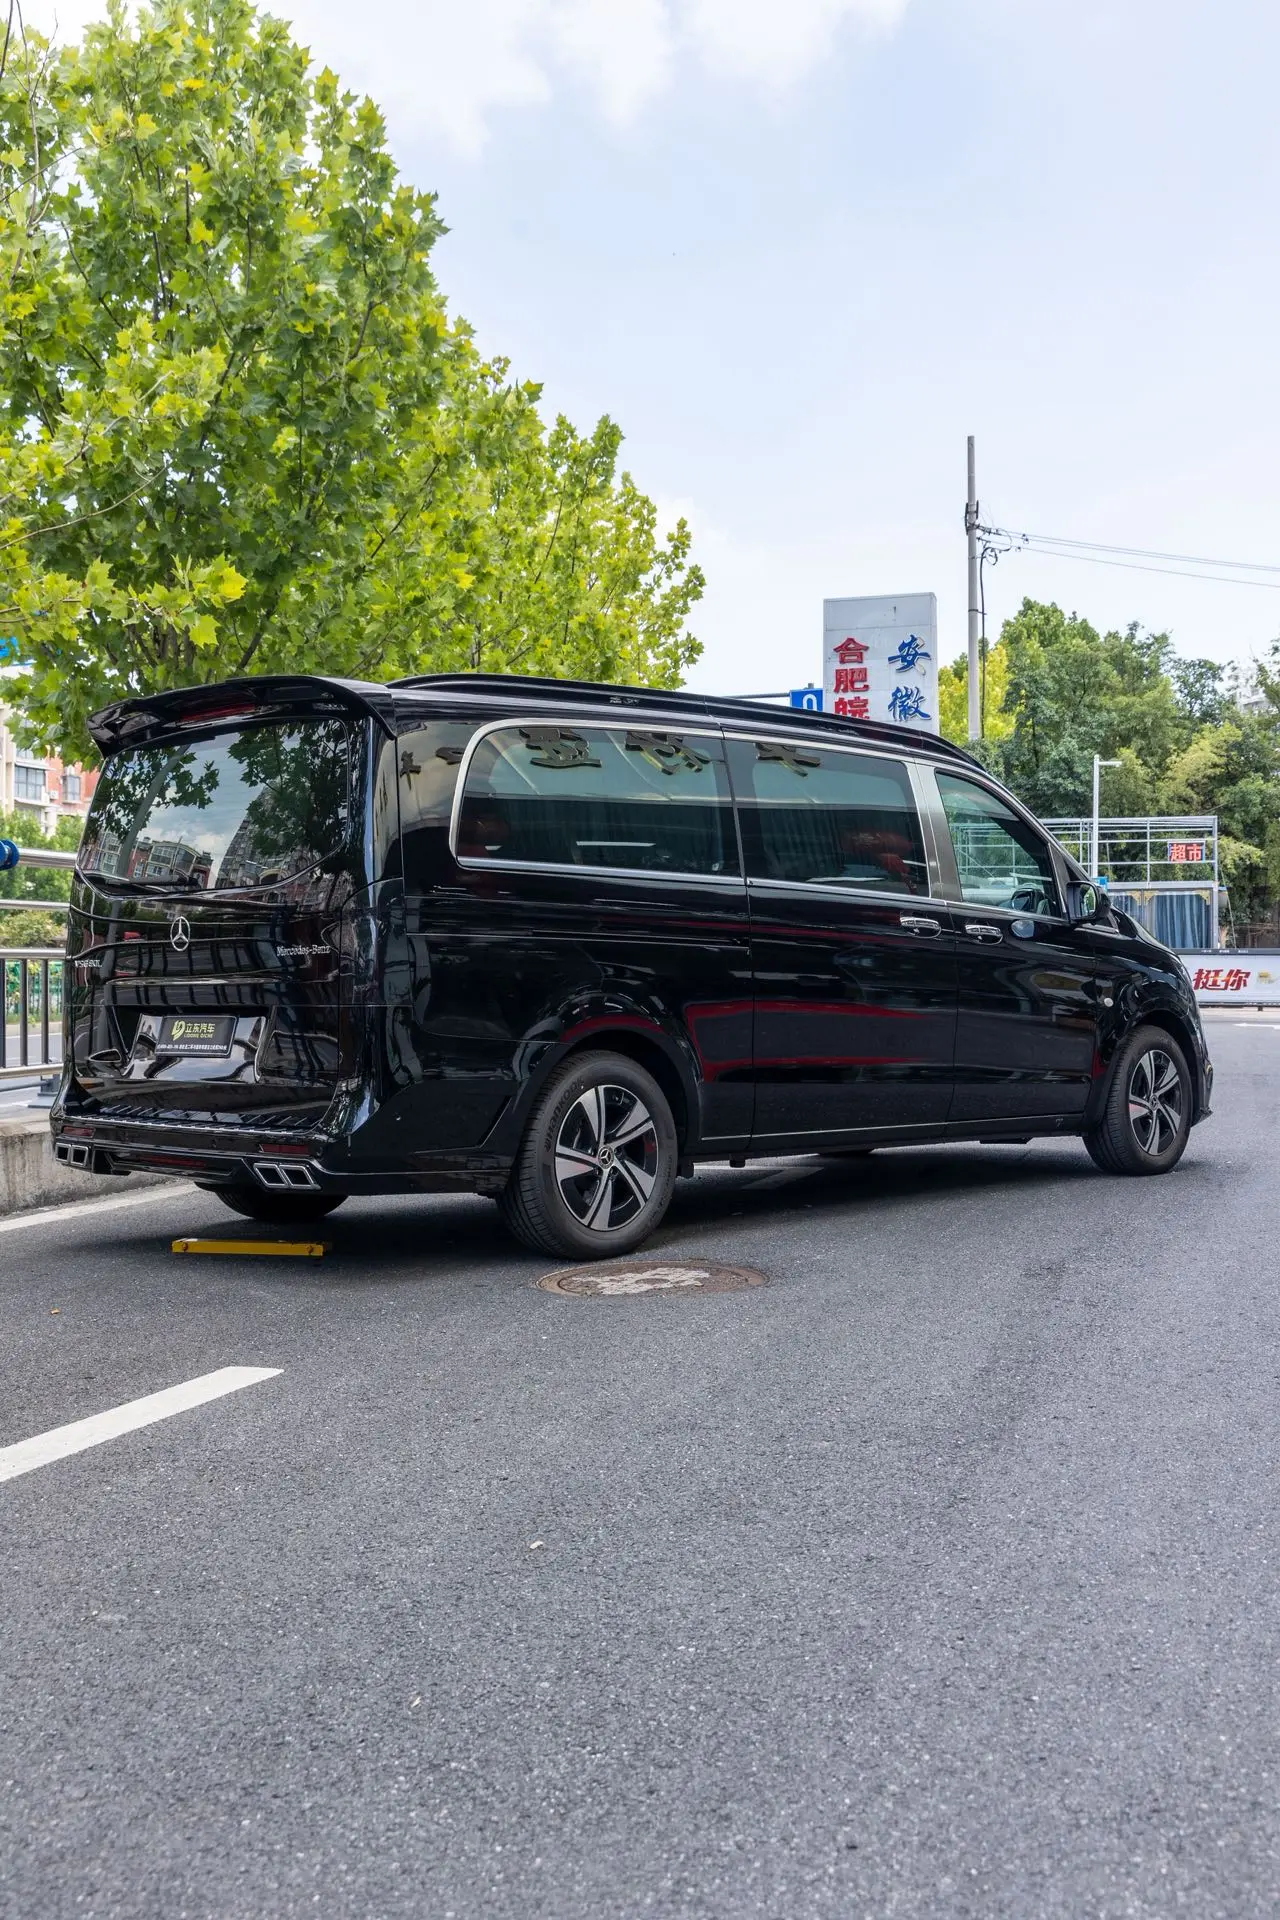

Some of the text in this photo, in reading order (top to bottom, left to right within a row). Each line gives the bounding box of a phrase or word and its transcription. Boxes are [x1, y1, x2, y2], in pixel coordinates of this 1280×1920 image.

[888, 634, 932, 721] 安徽
[1170, 843, 1202, 862] 超市
[276, 944, 331, 957] Mercedes-Benz
[1192, 968, 1251, 990] 挺你
